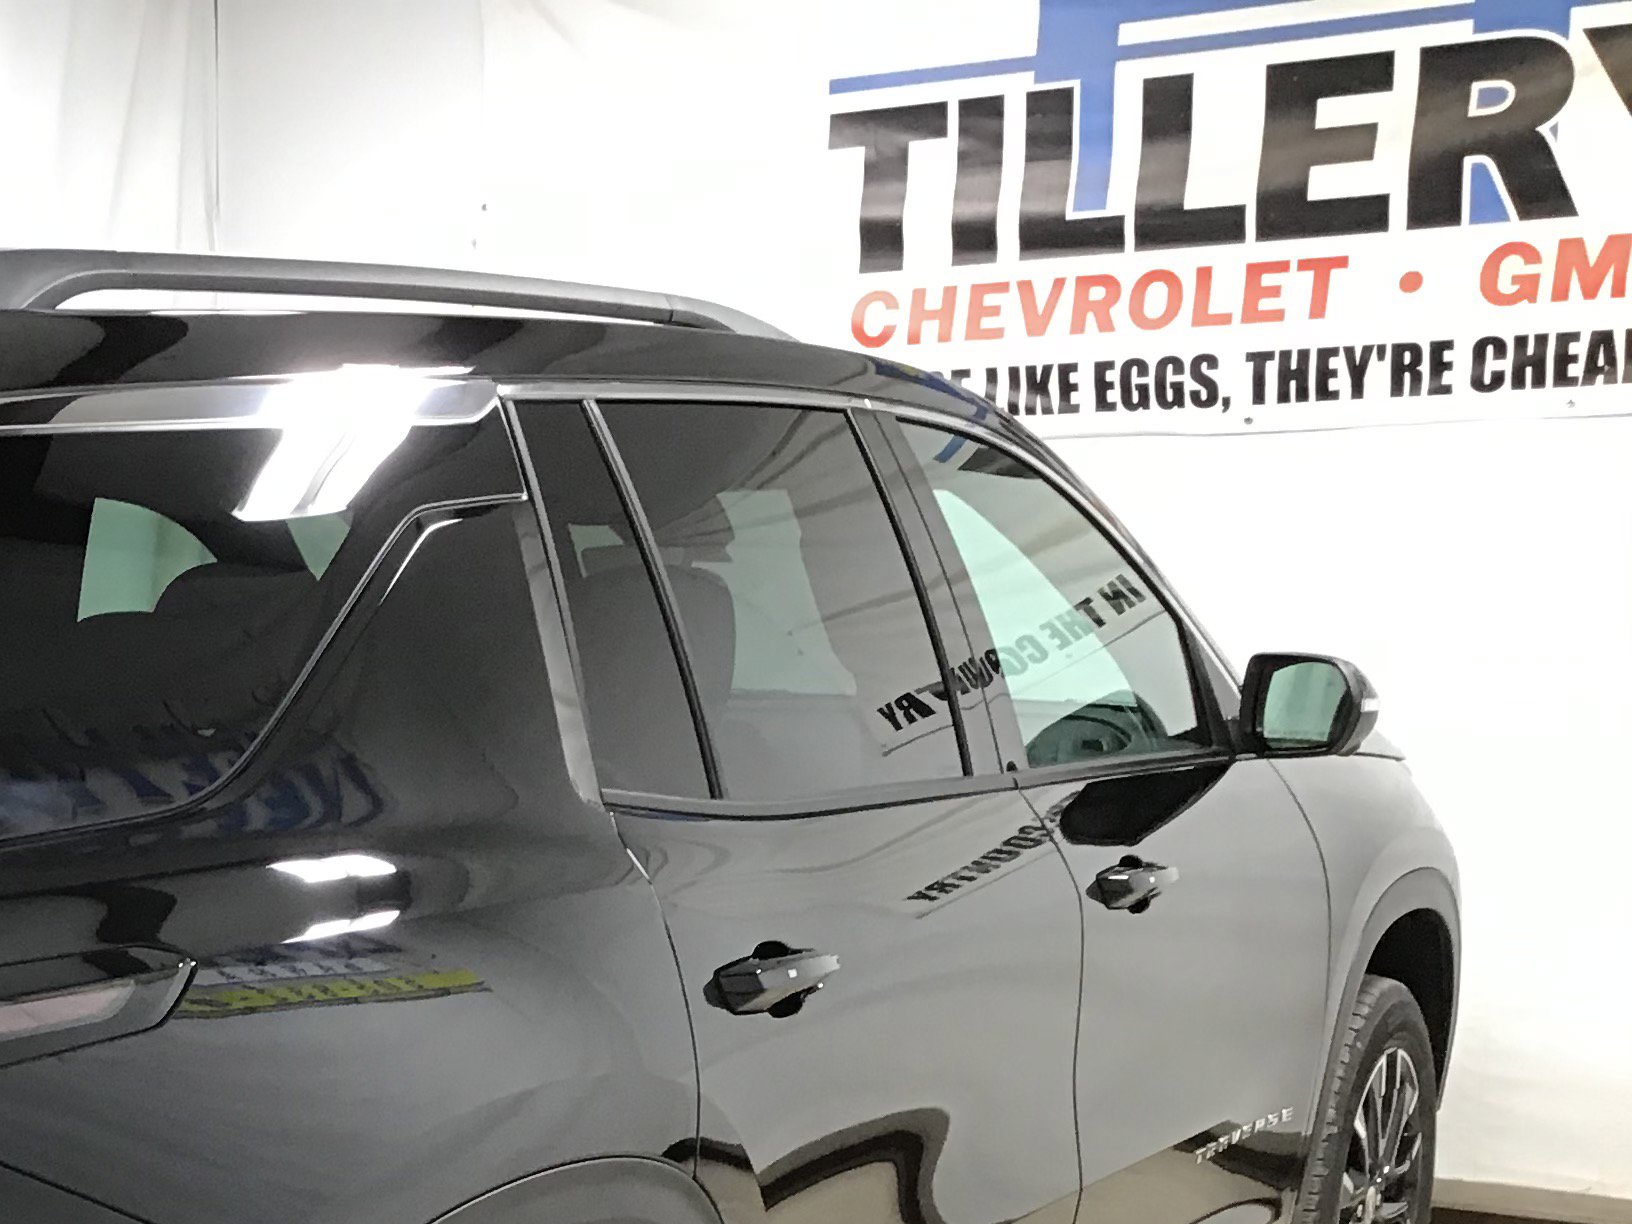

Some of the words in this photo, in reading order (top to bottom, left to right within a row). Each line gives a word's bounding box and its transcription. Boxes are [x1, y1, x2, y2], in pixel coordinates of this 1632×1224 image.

[828, 22, 1632, 274] TILLER
[850, 255, 1350, 349] CHEVROLET
[1094, 352, 1232, 415] EGGS,
[1246, 339, 1455, 403] THEY'RE
[1470, 328, 1632, 394] CHEA
